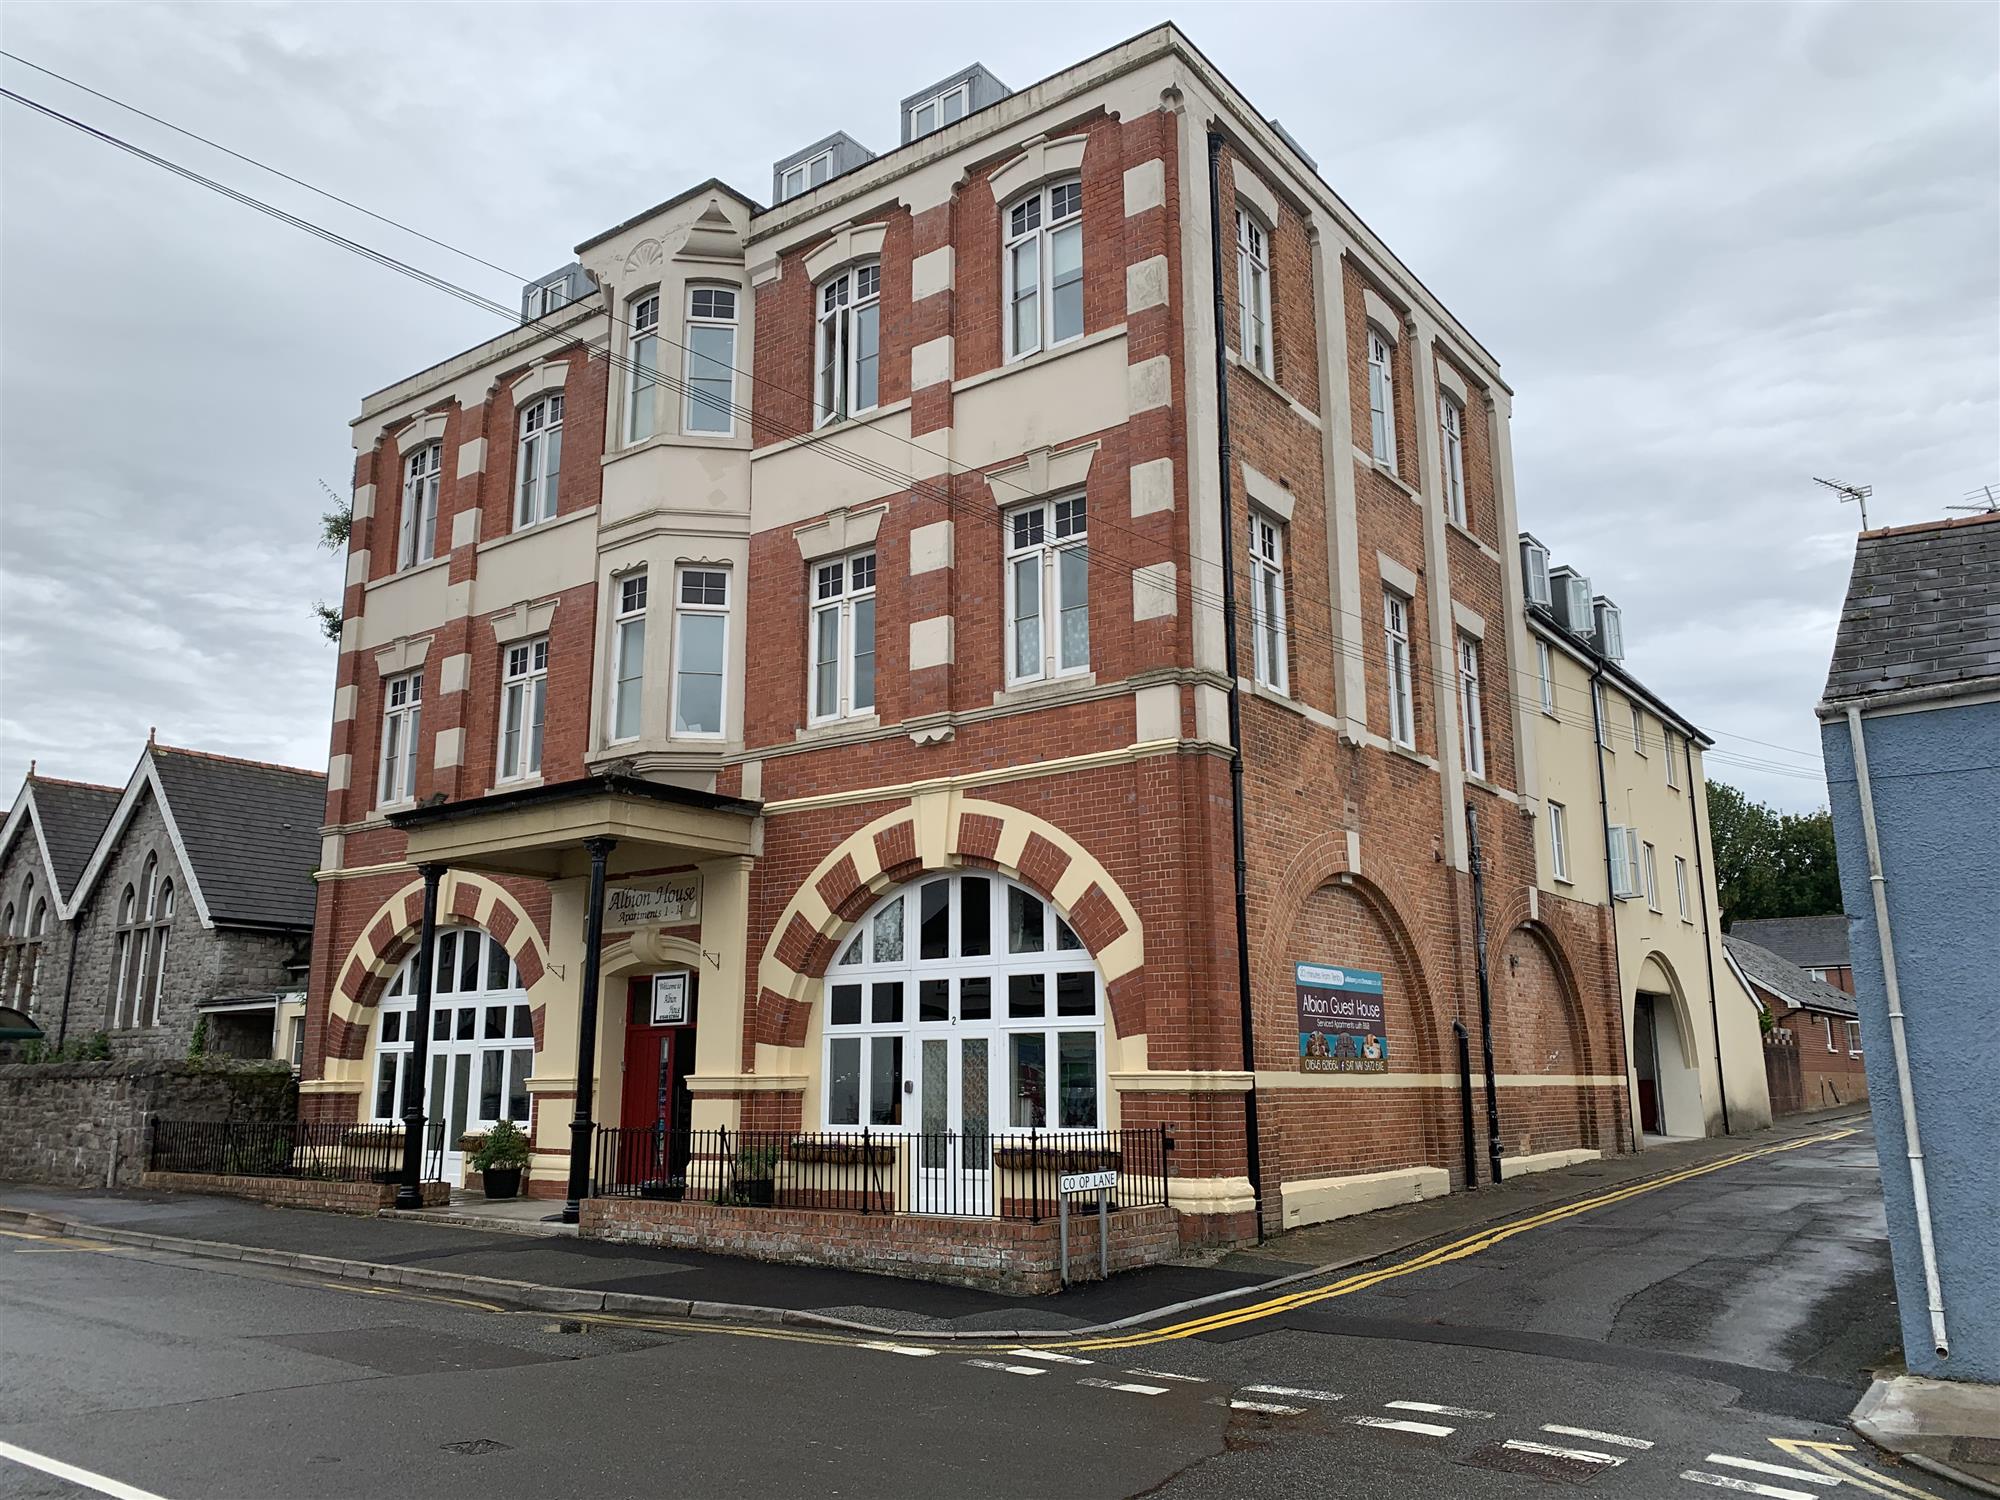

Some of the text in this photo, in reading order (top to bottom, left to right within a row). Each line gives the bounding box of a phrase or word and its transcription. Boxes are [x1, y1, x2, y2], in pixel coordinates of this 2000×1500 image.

[608, 881, 696, 911] Albion House
[618, 908, 662, 925] Apartments
[1302, 994, 1380, 1017] Albion Guest House
[951, 1016, 957, 1026] 2
[1316, 1018, 1334, 1028] Serviced
[1334, 1020, 1355, 1030] Apartments
[1063, 1173, 1115, 1190] CO OP LANE
